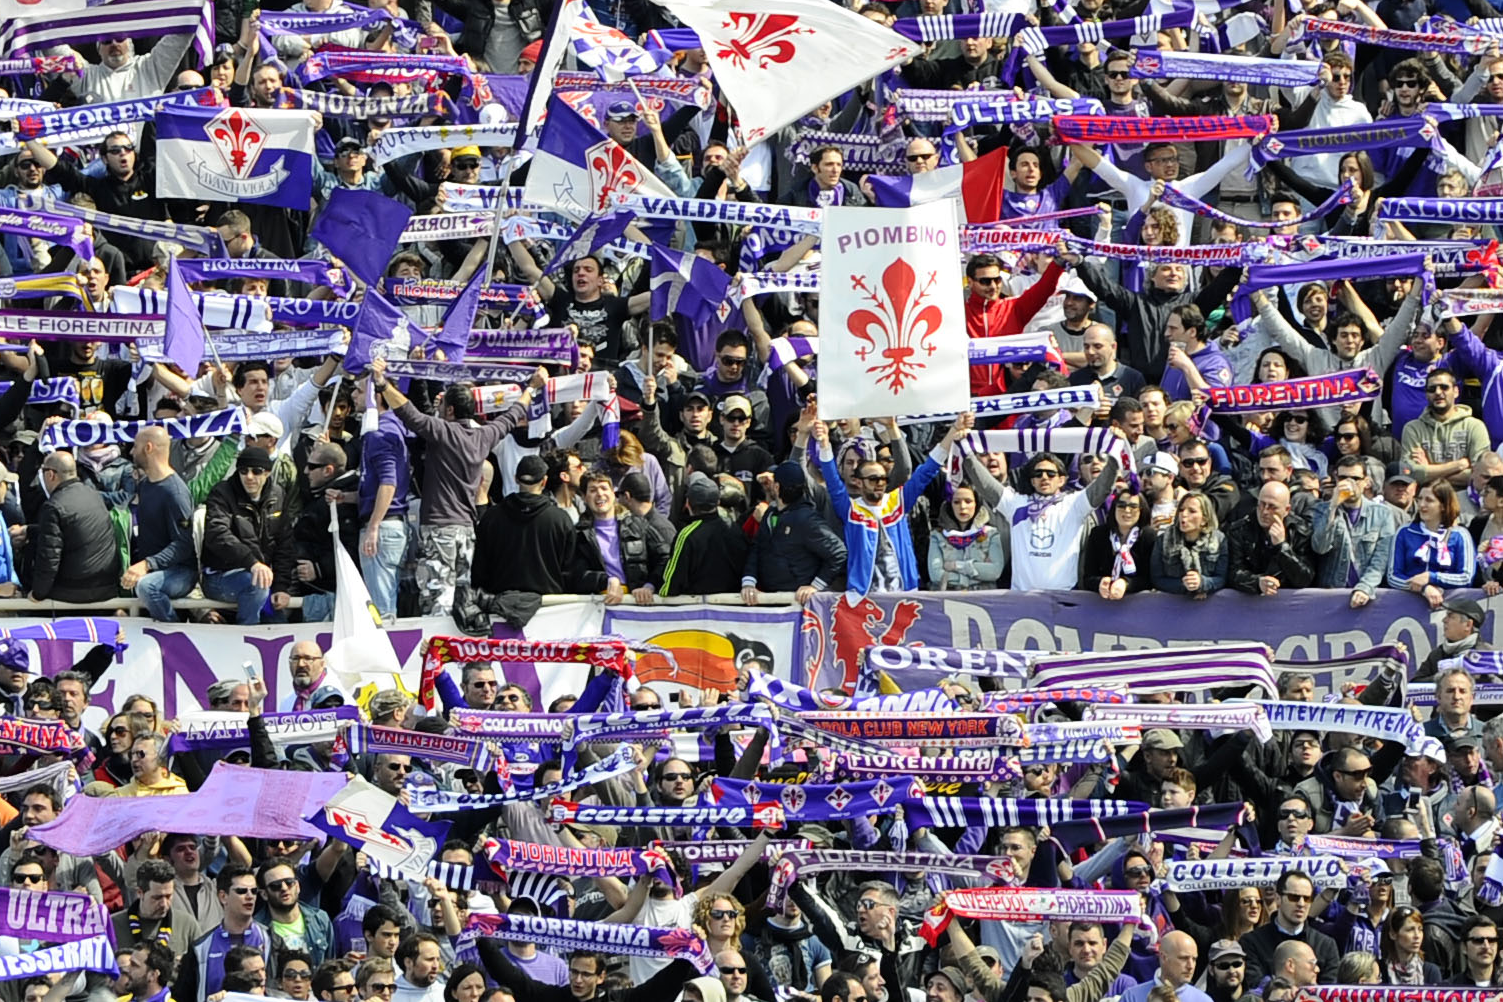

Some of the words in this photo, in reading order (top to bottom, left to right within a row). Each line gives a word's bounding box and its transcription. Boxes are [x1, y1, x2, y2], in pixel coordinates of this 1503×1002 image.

[953, 101, 1075, 125] ULTRAS
[643, 199, 791, 226] VALDELSA
[838, 225, 947, 254] PIOMBINO
[1162, 248, 1240, 260] FIORENTINA
[39, 318, 156, 335] FIORENTINA
[1214, 375, 1356, 409] FIORENTINA
[483, 719, 564, 733] COLLETTIVO
[865, 722, 900, 736] CLUB
[907, 722, 943, 735] NEW
[947, 720, 989, 735] YORK
[577, 807, 745, 823] COLLETTIVO
[511, 845, 632, 867] FIORENTINA
[1174, 861, 1339, 879] COLLETTIVO
[6, 889, 109, 934] ULTRA
[511, 916, 649, 946] FIORENTINA
